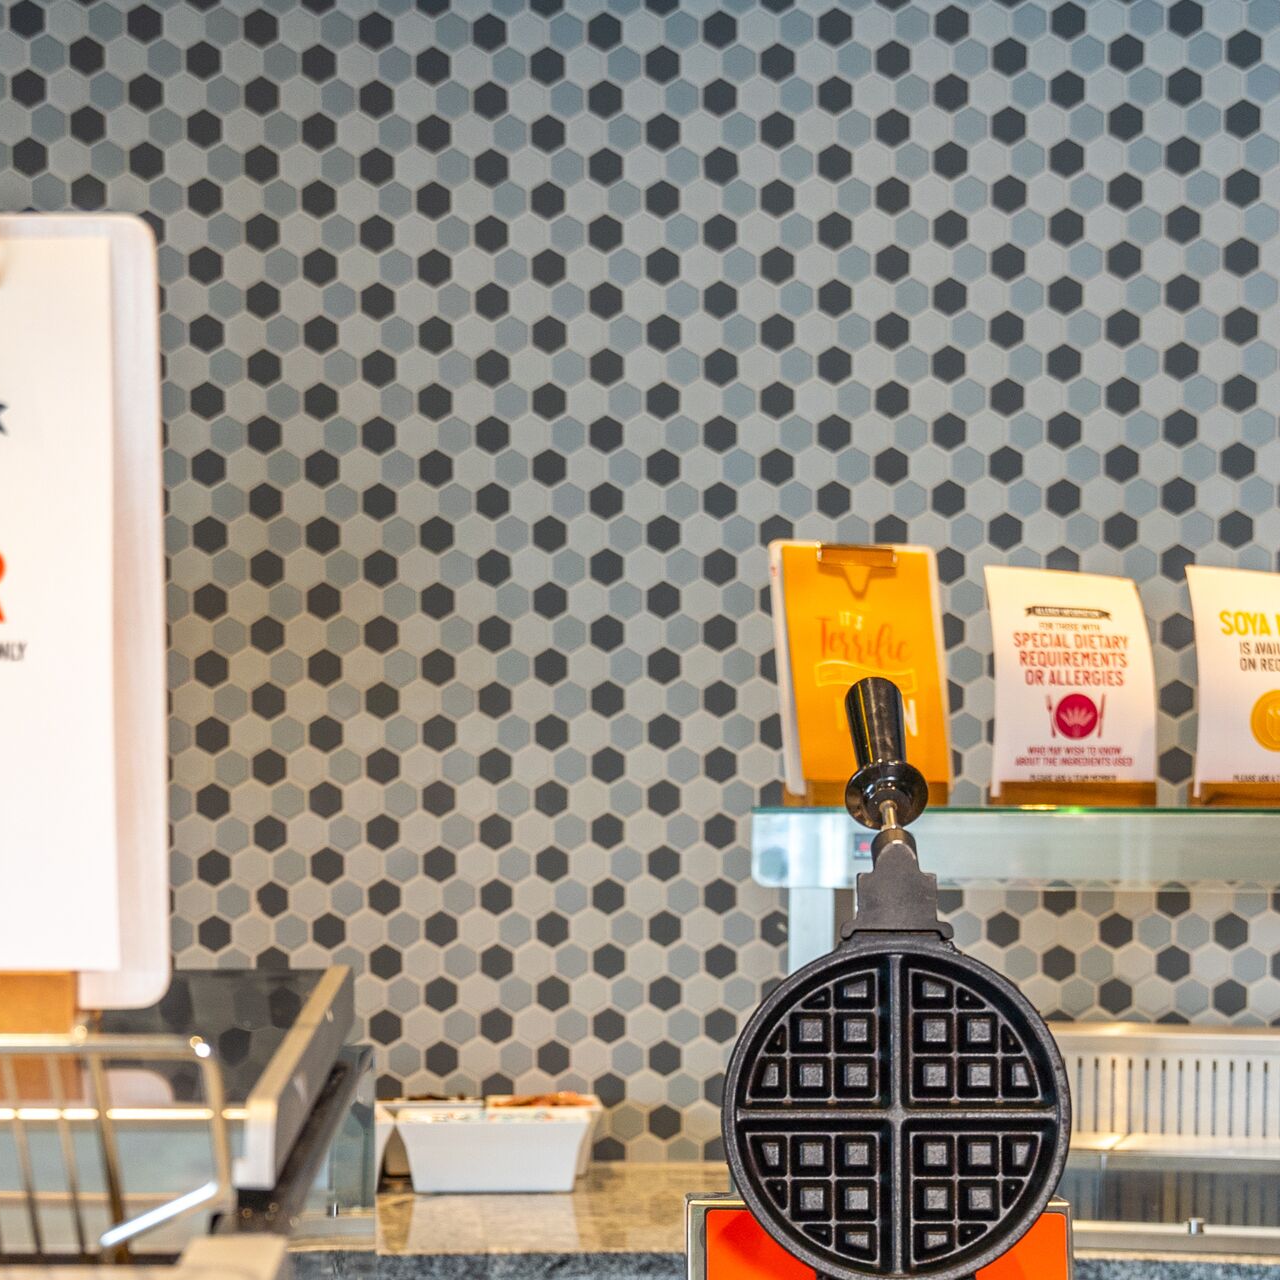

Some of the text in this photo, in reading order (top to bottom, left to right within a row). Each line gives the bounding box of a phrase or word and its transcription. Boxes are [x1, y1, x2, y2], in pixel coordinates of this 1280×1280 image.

[1219, 609, 1271, 636] SOYA
[1013, 632, 1129, 649] SPECIAL DIETARY
[1239, 641, 1251, 654] IS
[1019, 650, 1128, 668] REQUIREMENTS
[1239, 657, 1257, 671] ON
[1025, 669, 1124, 686] OR ALLERGIES
